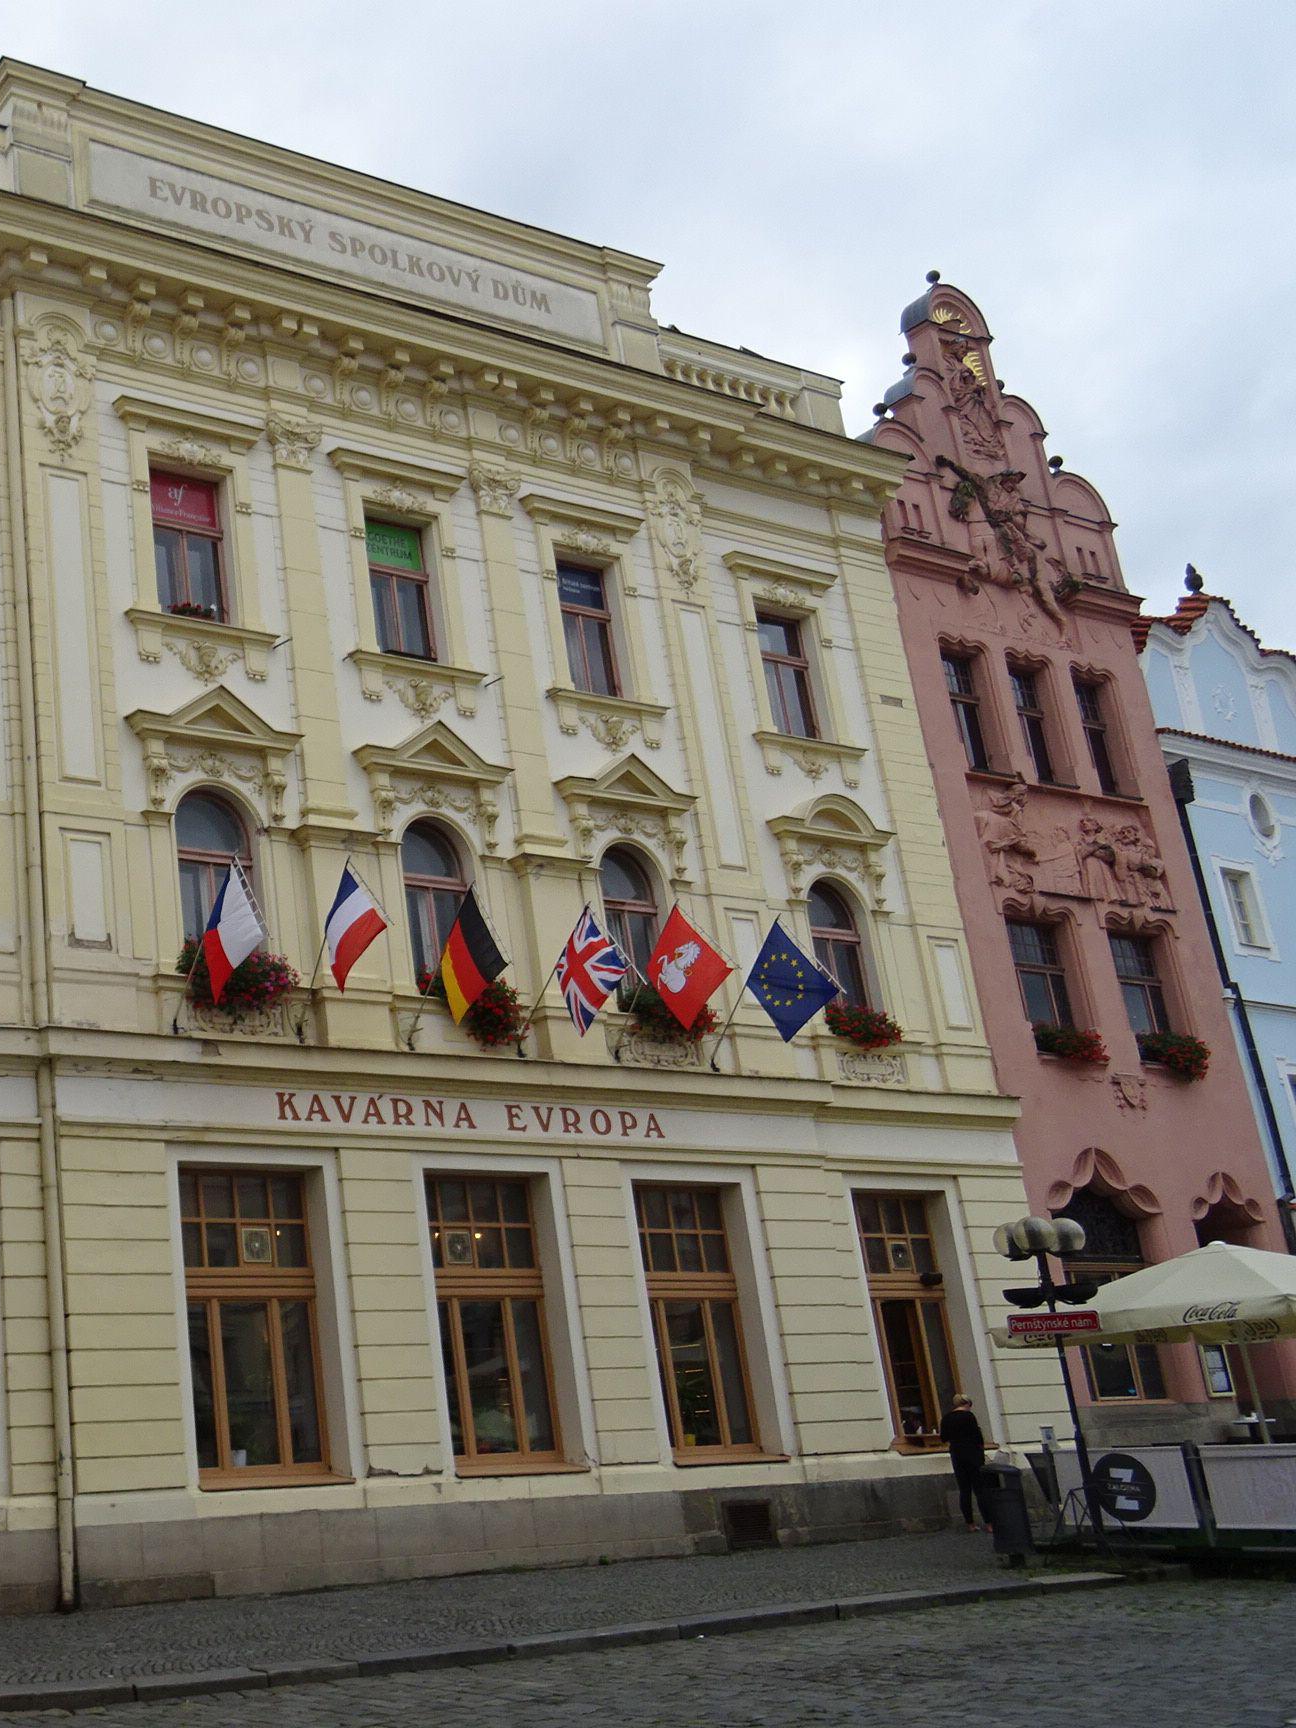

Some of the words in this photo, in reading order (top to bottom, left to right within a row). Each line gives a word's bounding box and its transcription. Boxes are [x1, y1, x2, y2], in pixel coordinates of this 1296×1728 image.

[148, 175, 314, 244] EVROPSKÝ
[328, 230, 482, 294] SPOLKOVÝ
[491, 276, 552, 315] DŮM
[275, 1091, 478, 1130] KAVÁRNA
[505, 1103, 666, 1139] EVROPA
